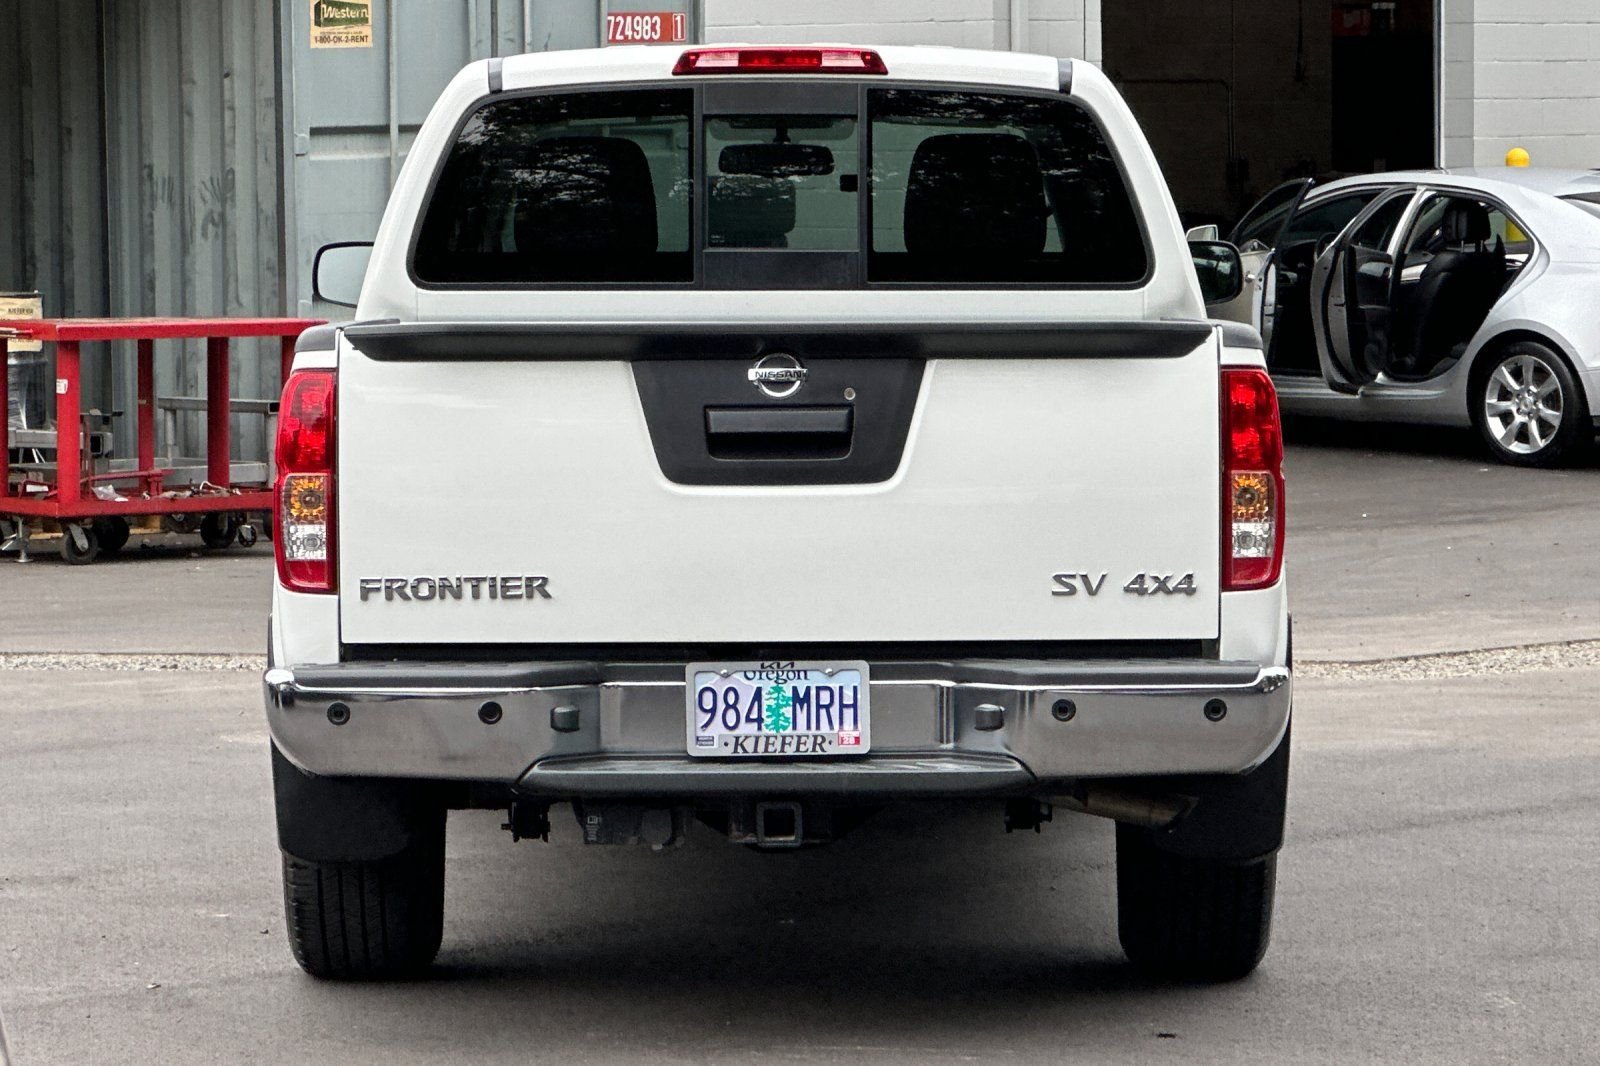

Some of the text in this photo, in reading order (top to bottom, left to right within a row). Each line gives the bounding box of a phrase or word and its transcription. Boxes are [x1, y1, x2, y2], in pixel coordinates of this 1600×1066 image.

[321, 4, 369, 19] Western
[607, 15, 682, 40] 724983 1
[315, 35, 369, 44] 1-800-OK-2-RENT
[755, 370, 803, 379] NISSAN
[359, 576, 552, 602] FRONTIER
[1051, 572, 1108, 596] SV
[744, 670, 810, 685] Oregon
[698, 685, 858, 731] 984 MRH
[731, 735, 828, 754] KIEFER
